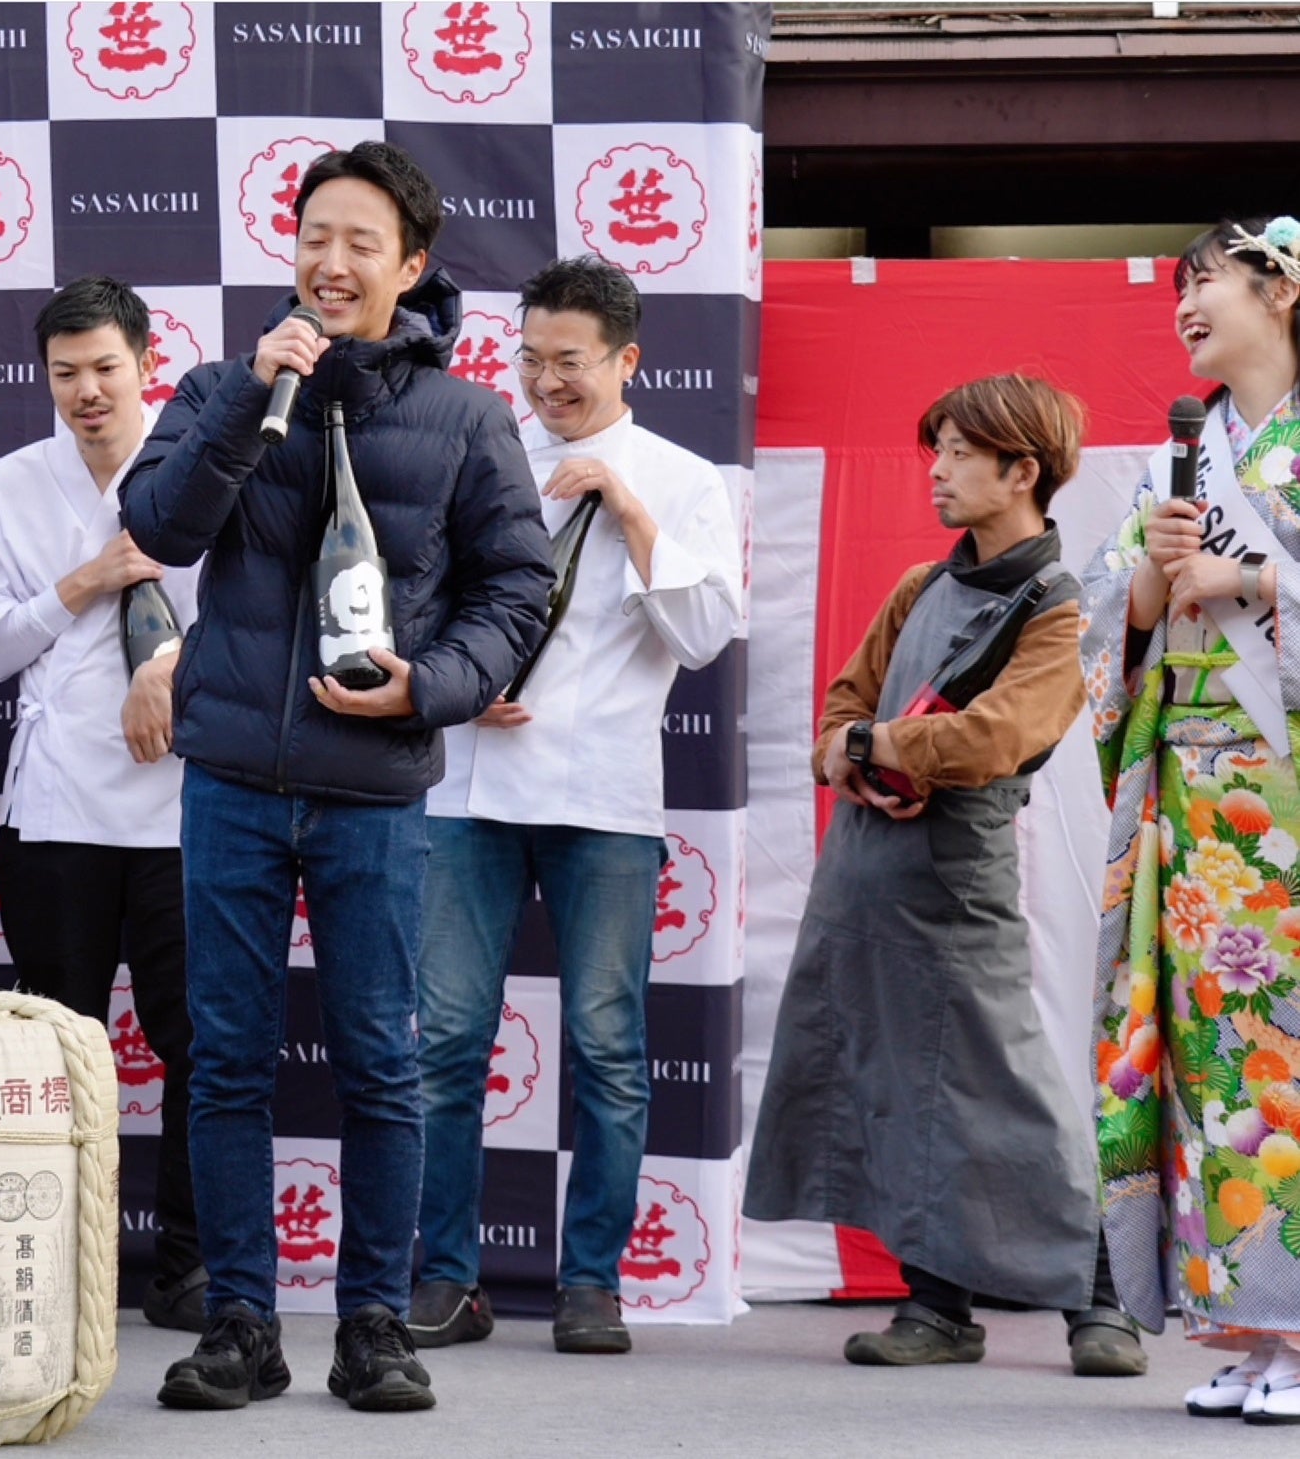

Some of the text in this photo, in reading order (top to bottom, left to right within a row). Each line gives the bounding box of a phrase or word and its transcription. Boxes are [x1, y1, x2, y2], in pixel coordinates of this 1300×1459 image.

[234, 24, 360, 44] SASAICHI
[571, 29, 700, 48] SASAICHI
[72, 193, 198, 212] SASAICHI
